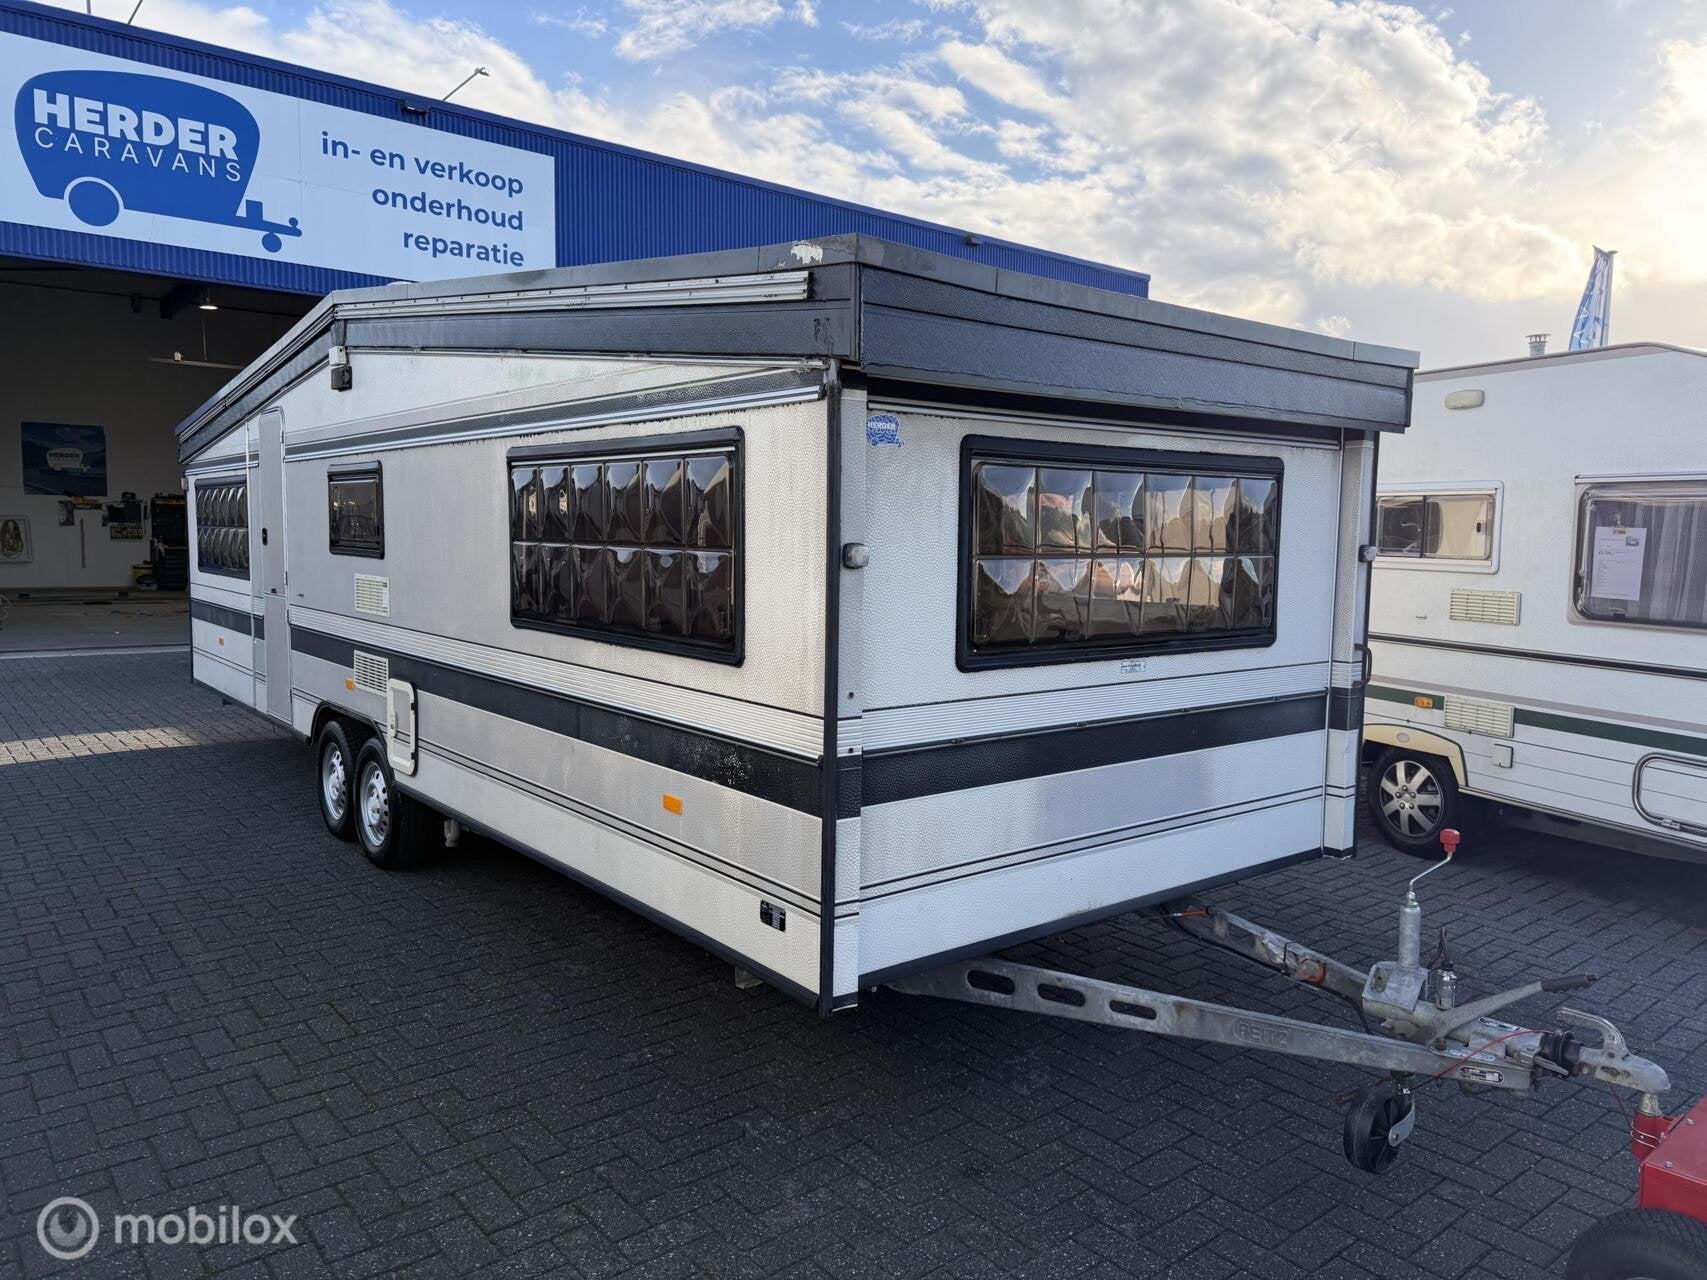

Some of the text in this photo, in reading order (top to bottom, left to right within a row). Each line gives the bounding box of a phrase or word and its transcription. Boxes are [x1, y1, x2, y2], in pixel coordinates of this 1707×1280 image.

[33, 88, 238, 161] HERDER
[34, 126, 241, 182] CARAVANS
[321, 130, 524, 198] in- en verkoop
[372, 188, 523, 231] onderhoud
[403, 231, 525, 267] reparatie
